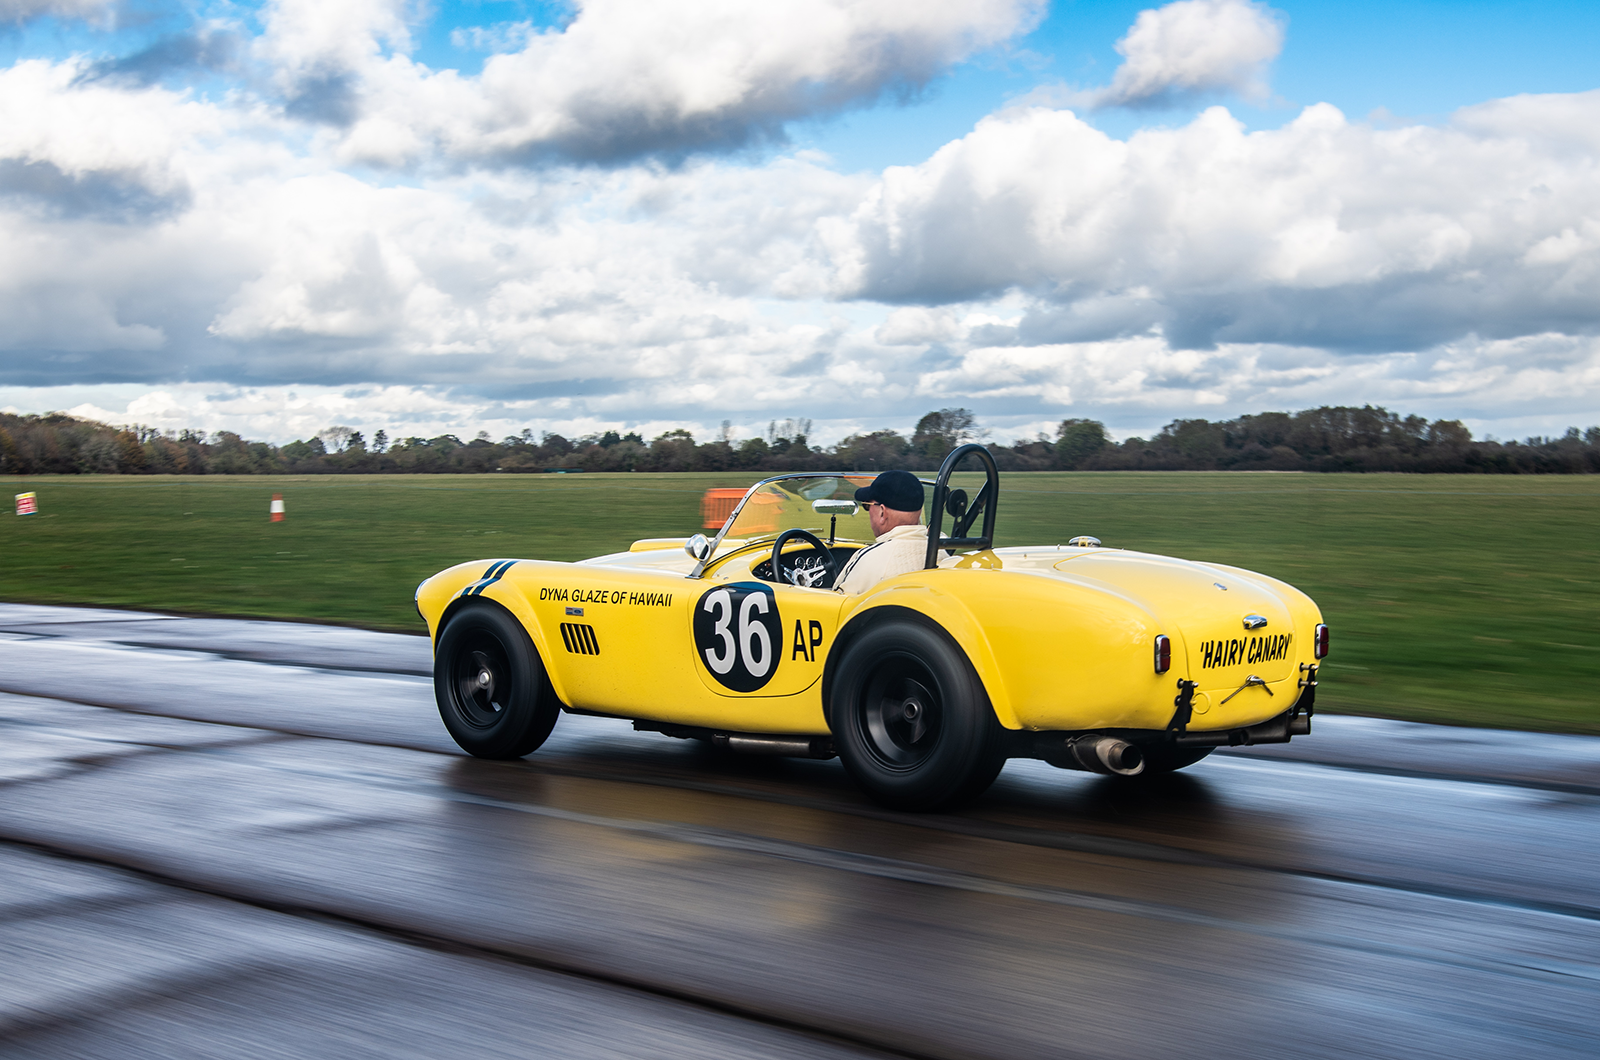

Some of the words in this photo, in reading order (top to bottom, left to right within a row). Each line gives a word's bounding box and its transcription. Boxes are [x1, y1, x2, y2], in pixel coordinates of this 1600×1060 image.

[539, 587, 568, 601] DYNA
[571, 589, 609, 604] GLAZE
[611, 591, 627, 604] OF
[629, 592, 673, 607] HAWAII
[703, 588, 772, 678] 36
[791, 619, 823, 662] AP
